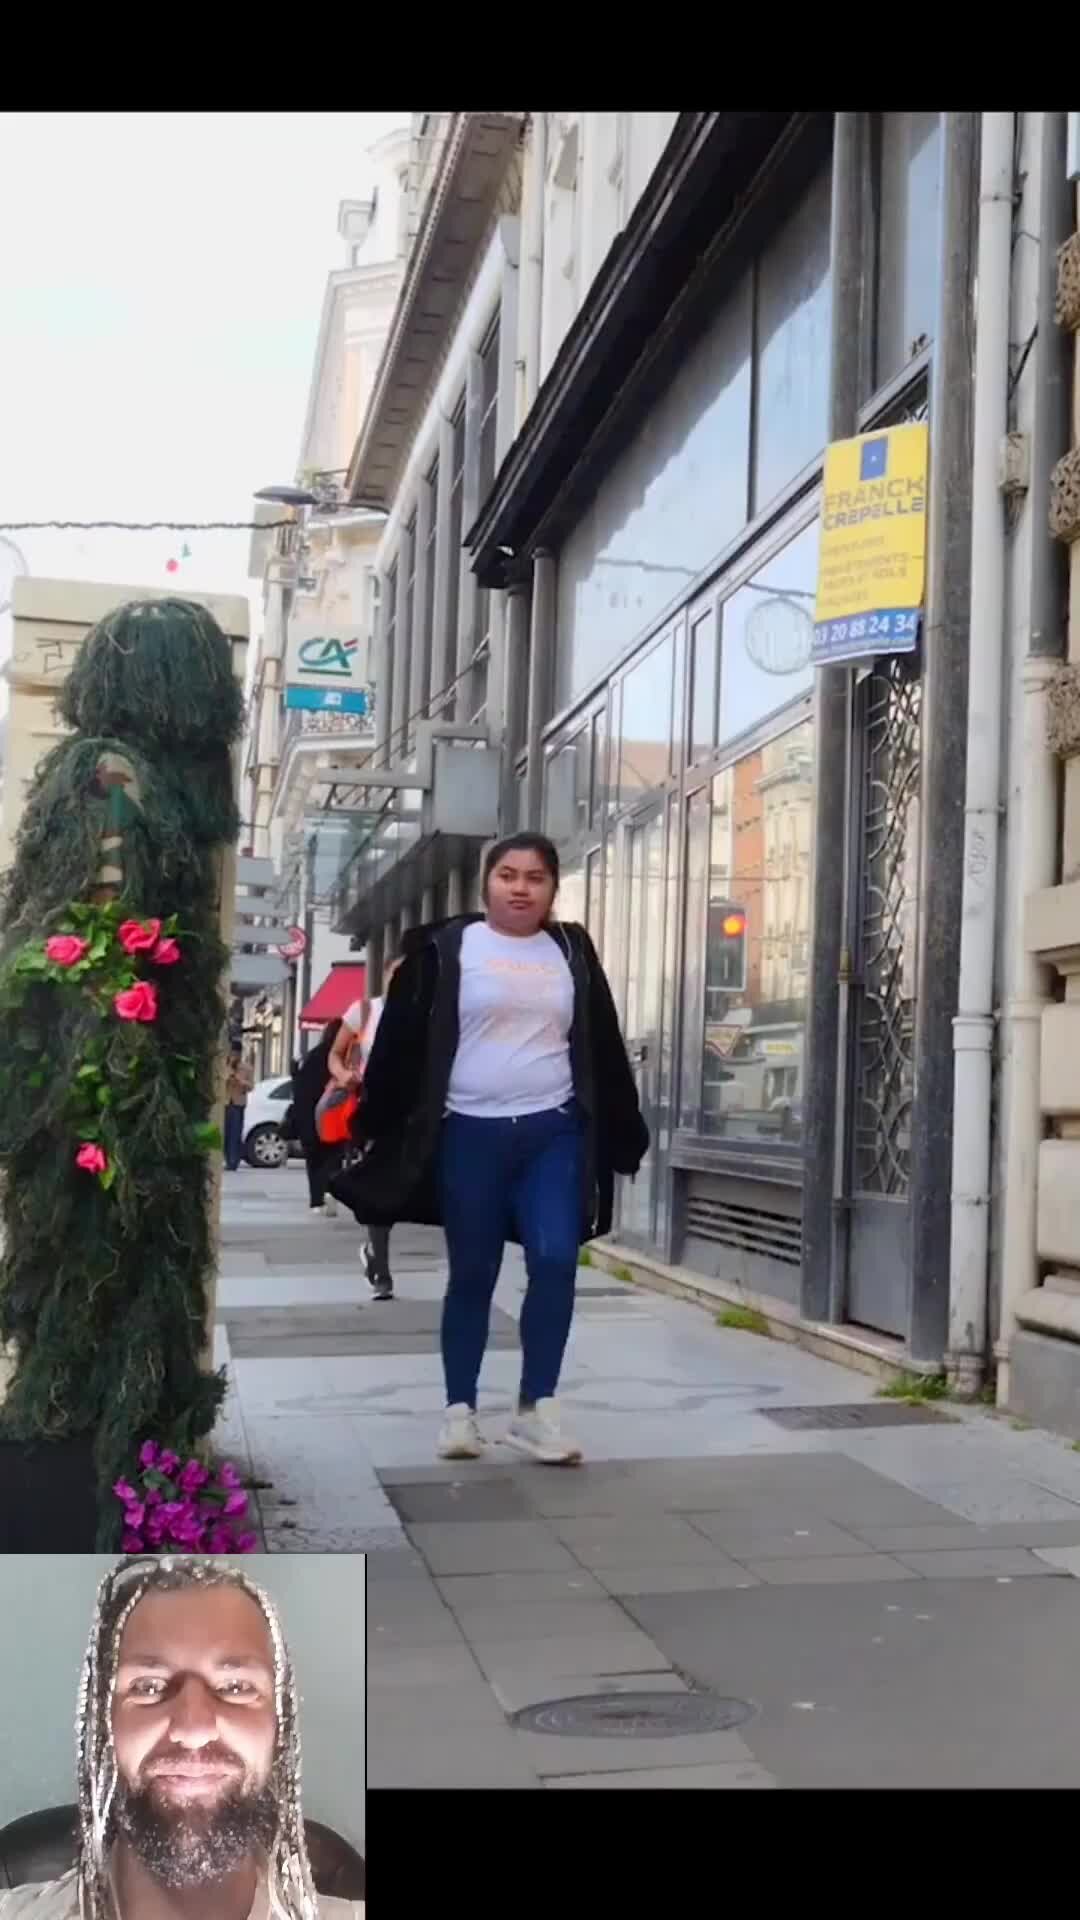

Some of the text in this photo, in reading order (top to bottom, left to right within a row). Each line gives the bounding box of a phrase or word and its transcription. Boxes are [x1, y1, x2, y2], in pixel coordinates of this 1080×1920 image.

[824, 476, 924, 512] FRANCK
[823, 496, 924, 531] CREPELLE
[831, 623, 848, 641] 20
[868, 614, 890, 633] 24
[894, 613, 915, 633] 34
